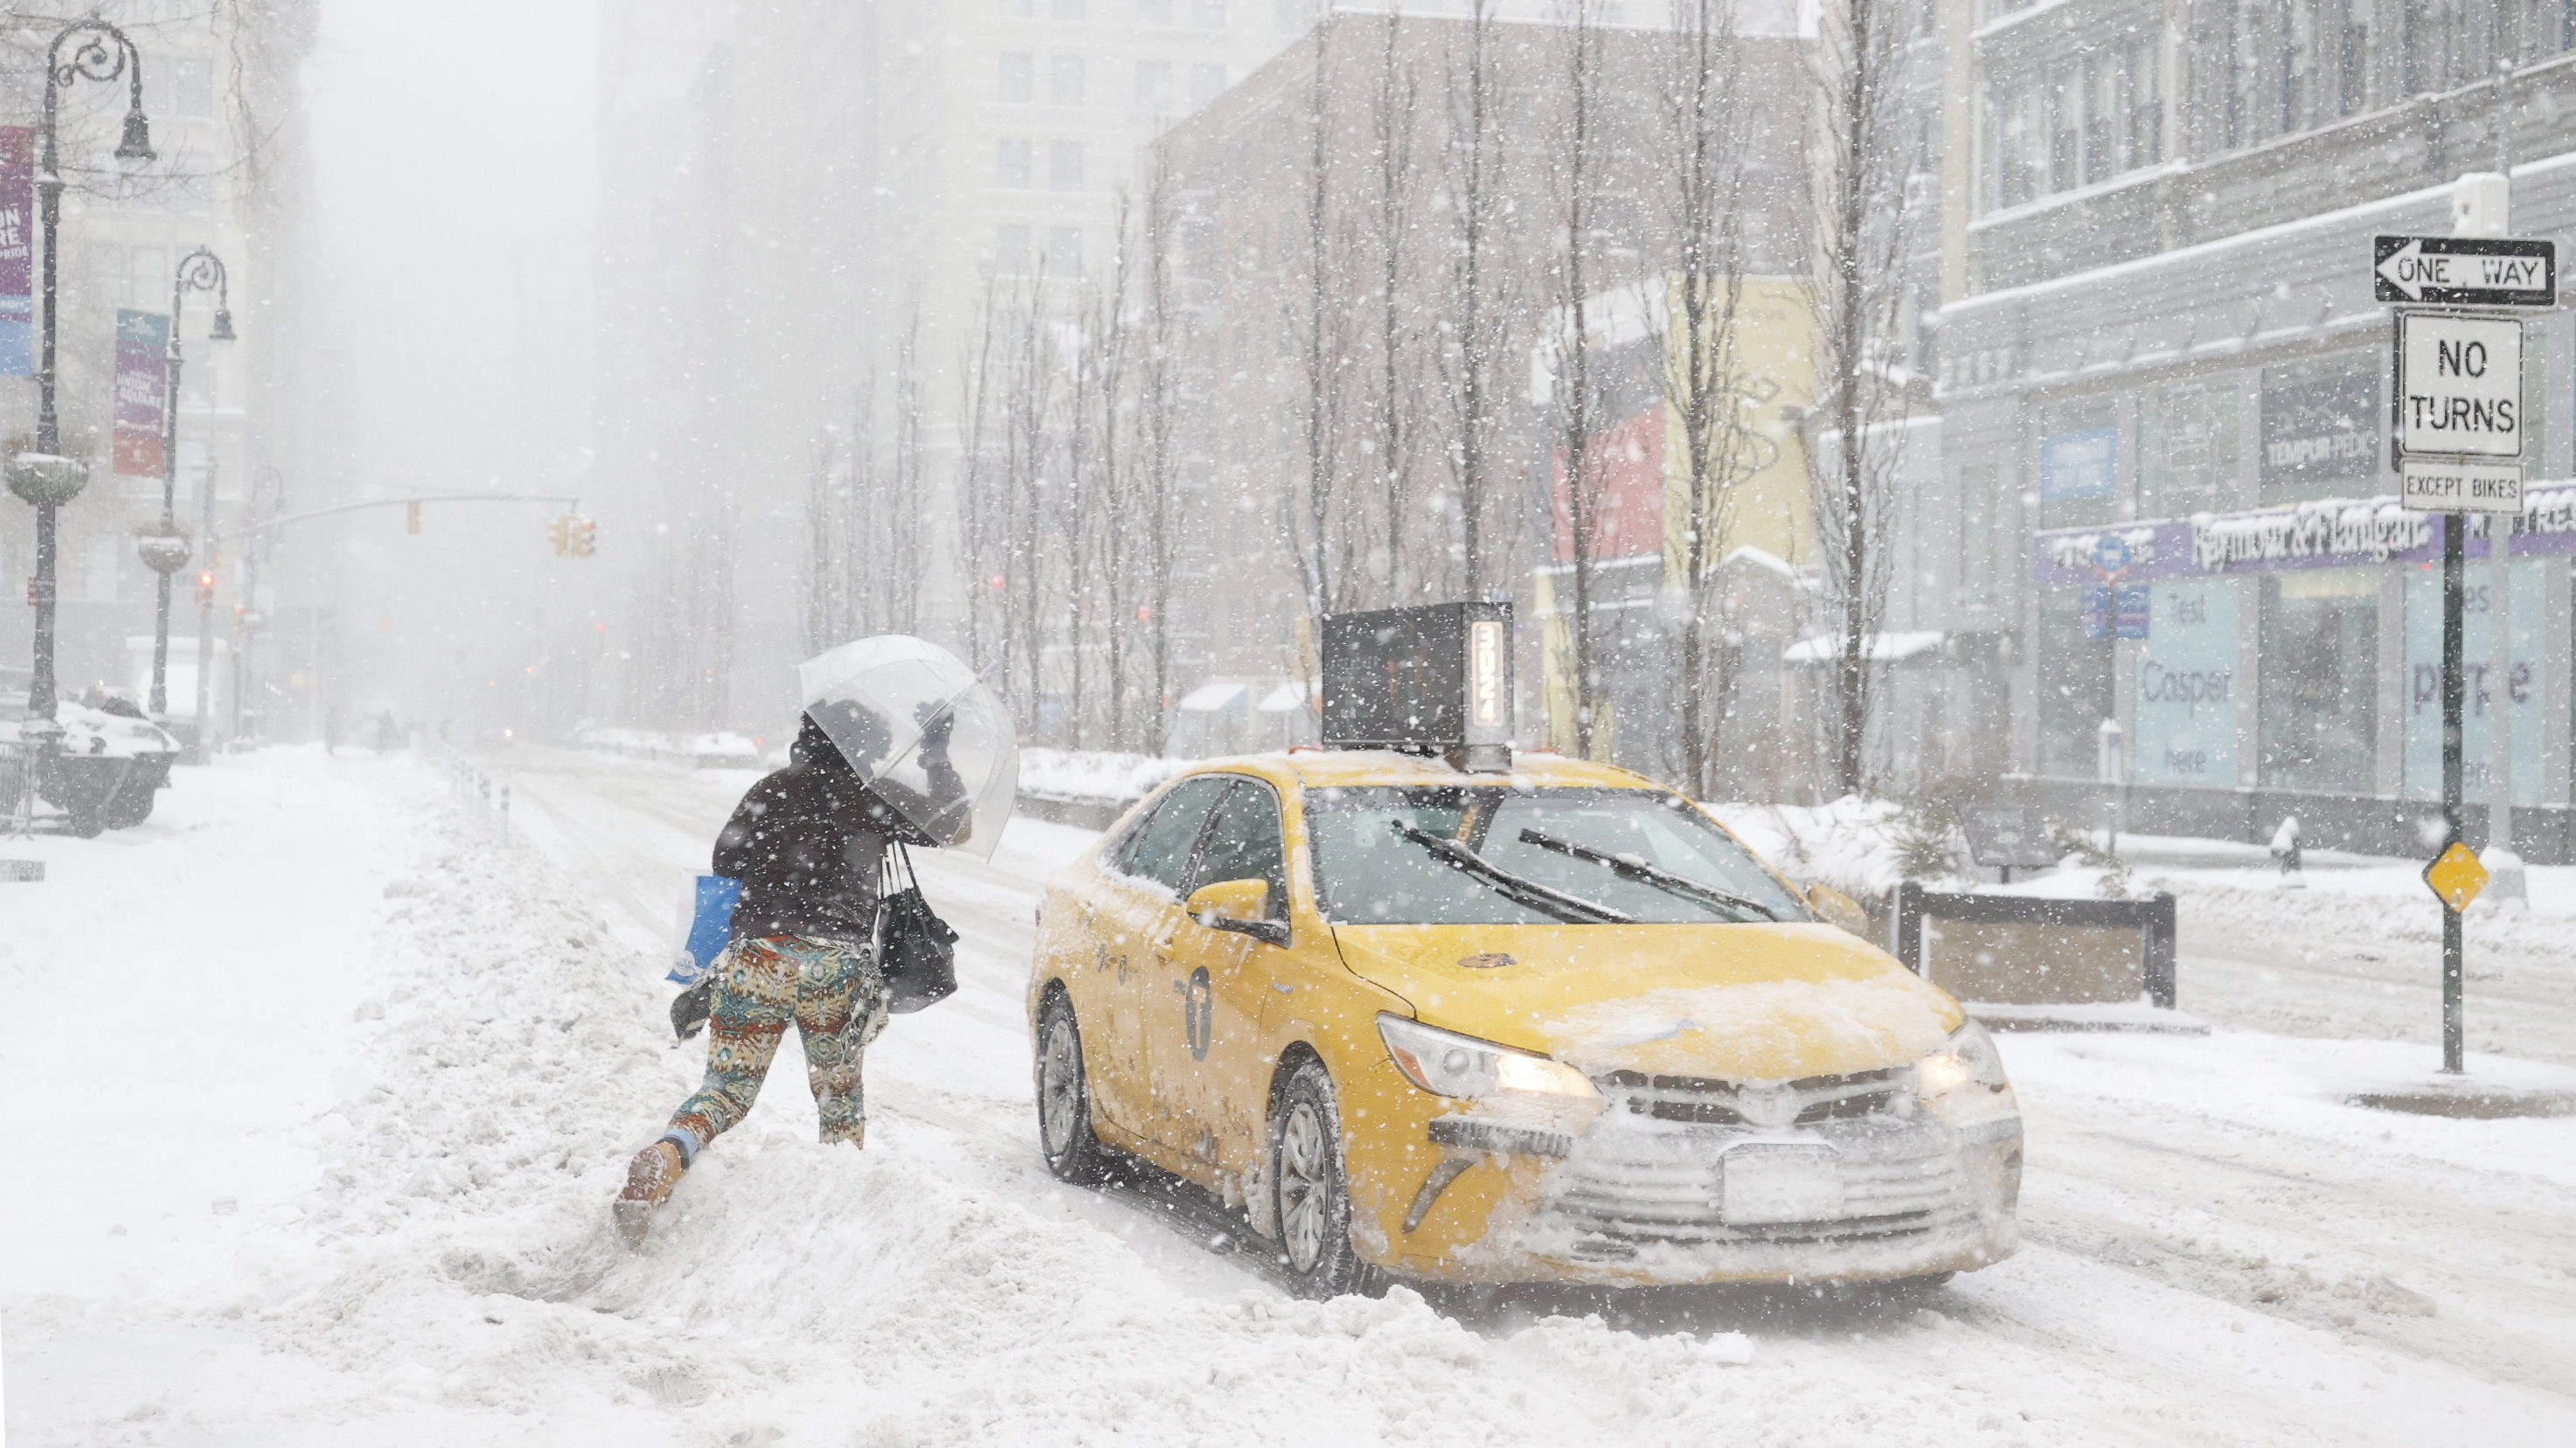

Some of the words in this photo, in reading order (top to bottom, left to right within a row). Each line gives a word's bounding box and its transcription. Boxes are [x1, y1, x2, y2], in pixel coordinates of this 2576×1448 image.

[2399, 259, 2450, 283] ONE
[2482, 260, 2539, 286] WAY
[2439, 340, 2488, 378] NO
[2410, 395, 2515, 433] TURNS
[2407, 475, 2464, 496] EXCEPT
[2473, 478, 2518, 499] BIKES
[2169, 593, 2205, 623] Test
[2144, 660, 2232, 718] Casper
[2413, 662, 2531, 716] ppe
